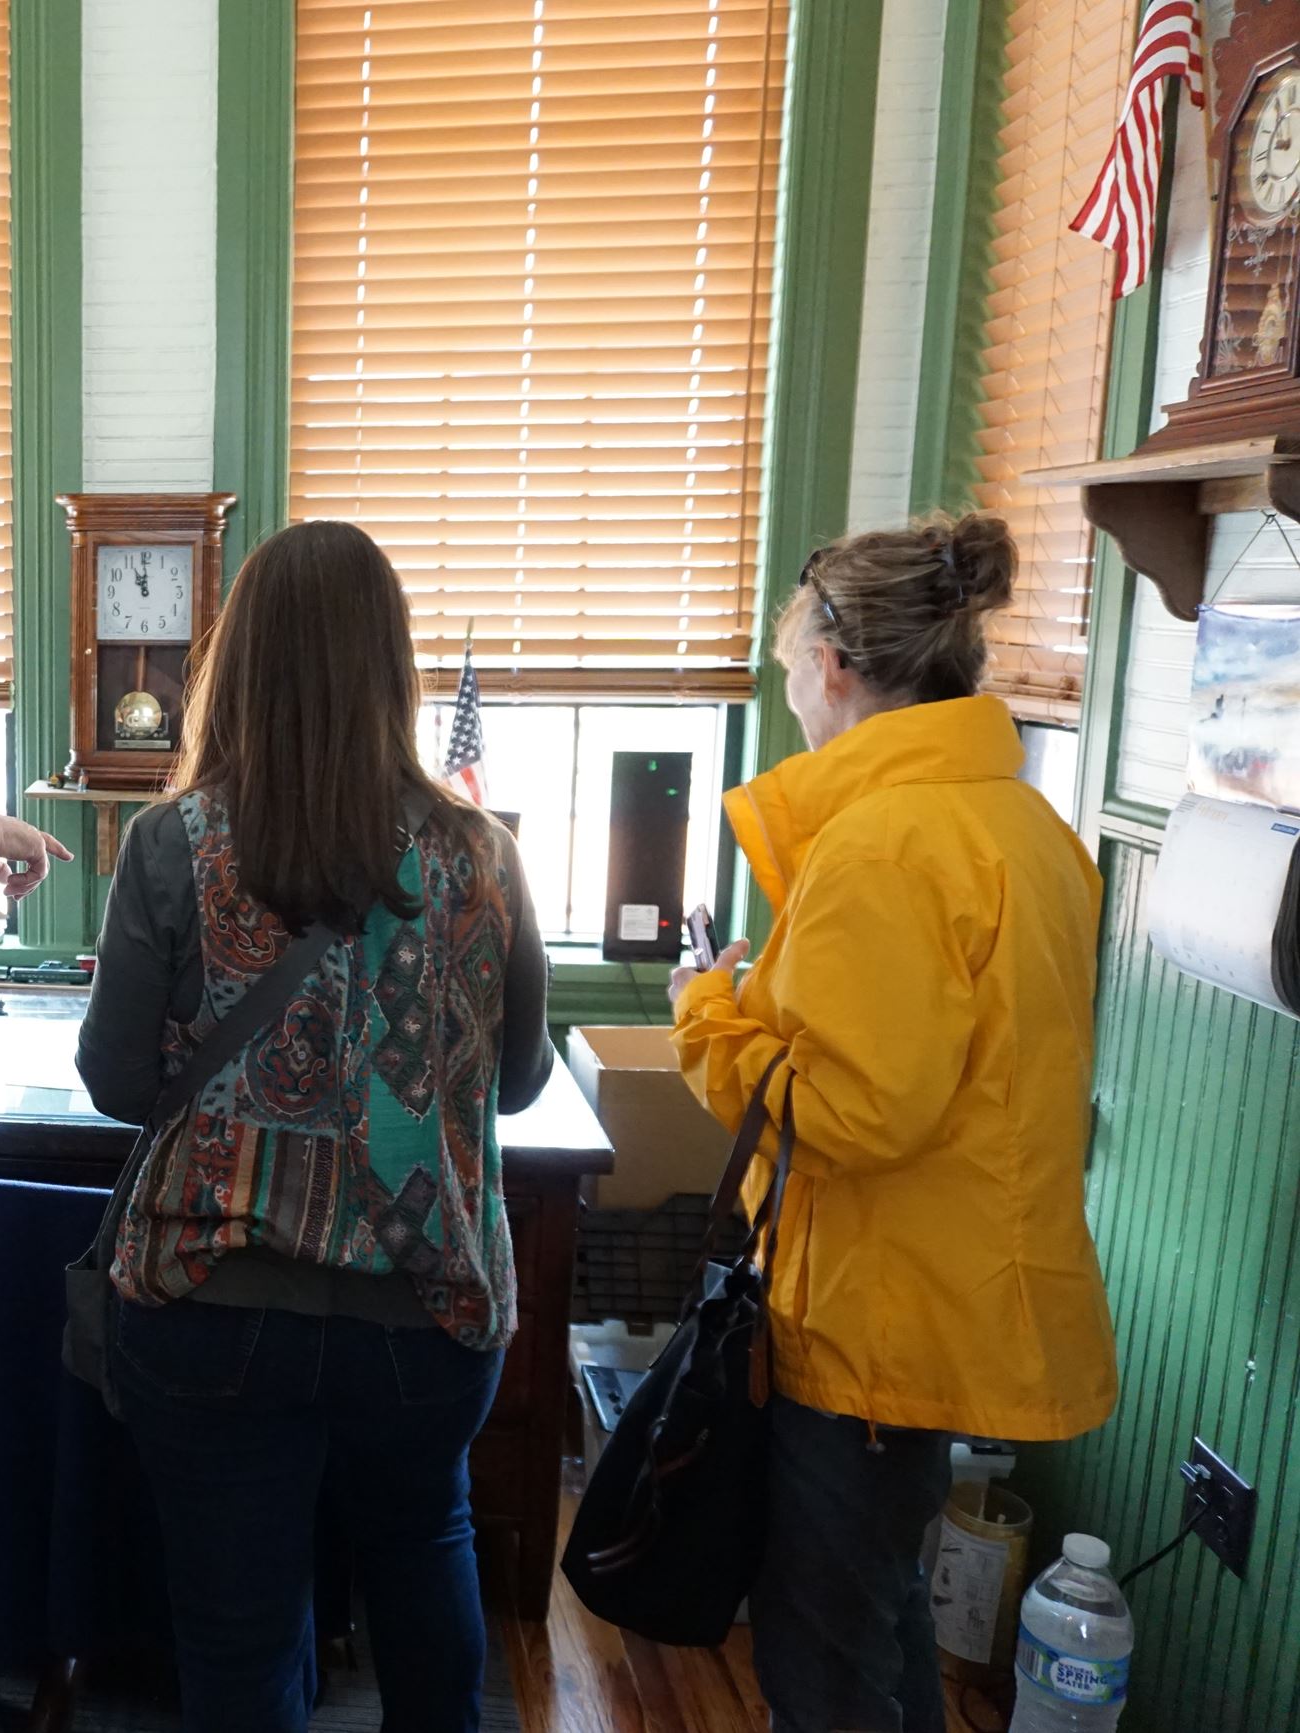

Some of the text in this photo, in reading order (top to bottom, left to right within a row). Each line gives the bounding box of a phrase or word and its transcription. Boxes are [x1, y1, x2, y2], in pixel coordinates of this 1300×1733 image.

[125, 554, 134, 569] 11
[110, 567, 123, 582] 10
[170, 567, 178, 582] 2
[107, 585, 115, 599] 9
[175, 585, 183, 600] 3
[112, 601, 121, 617] 8
[124, 615, 133, 629] 7
[140, 619, 149, 634] 6
[158, 615, 166, 629] 5
[1057, 1667, 1108, 1685] SPRING
